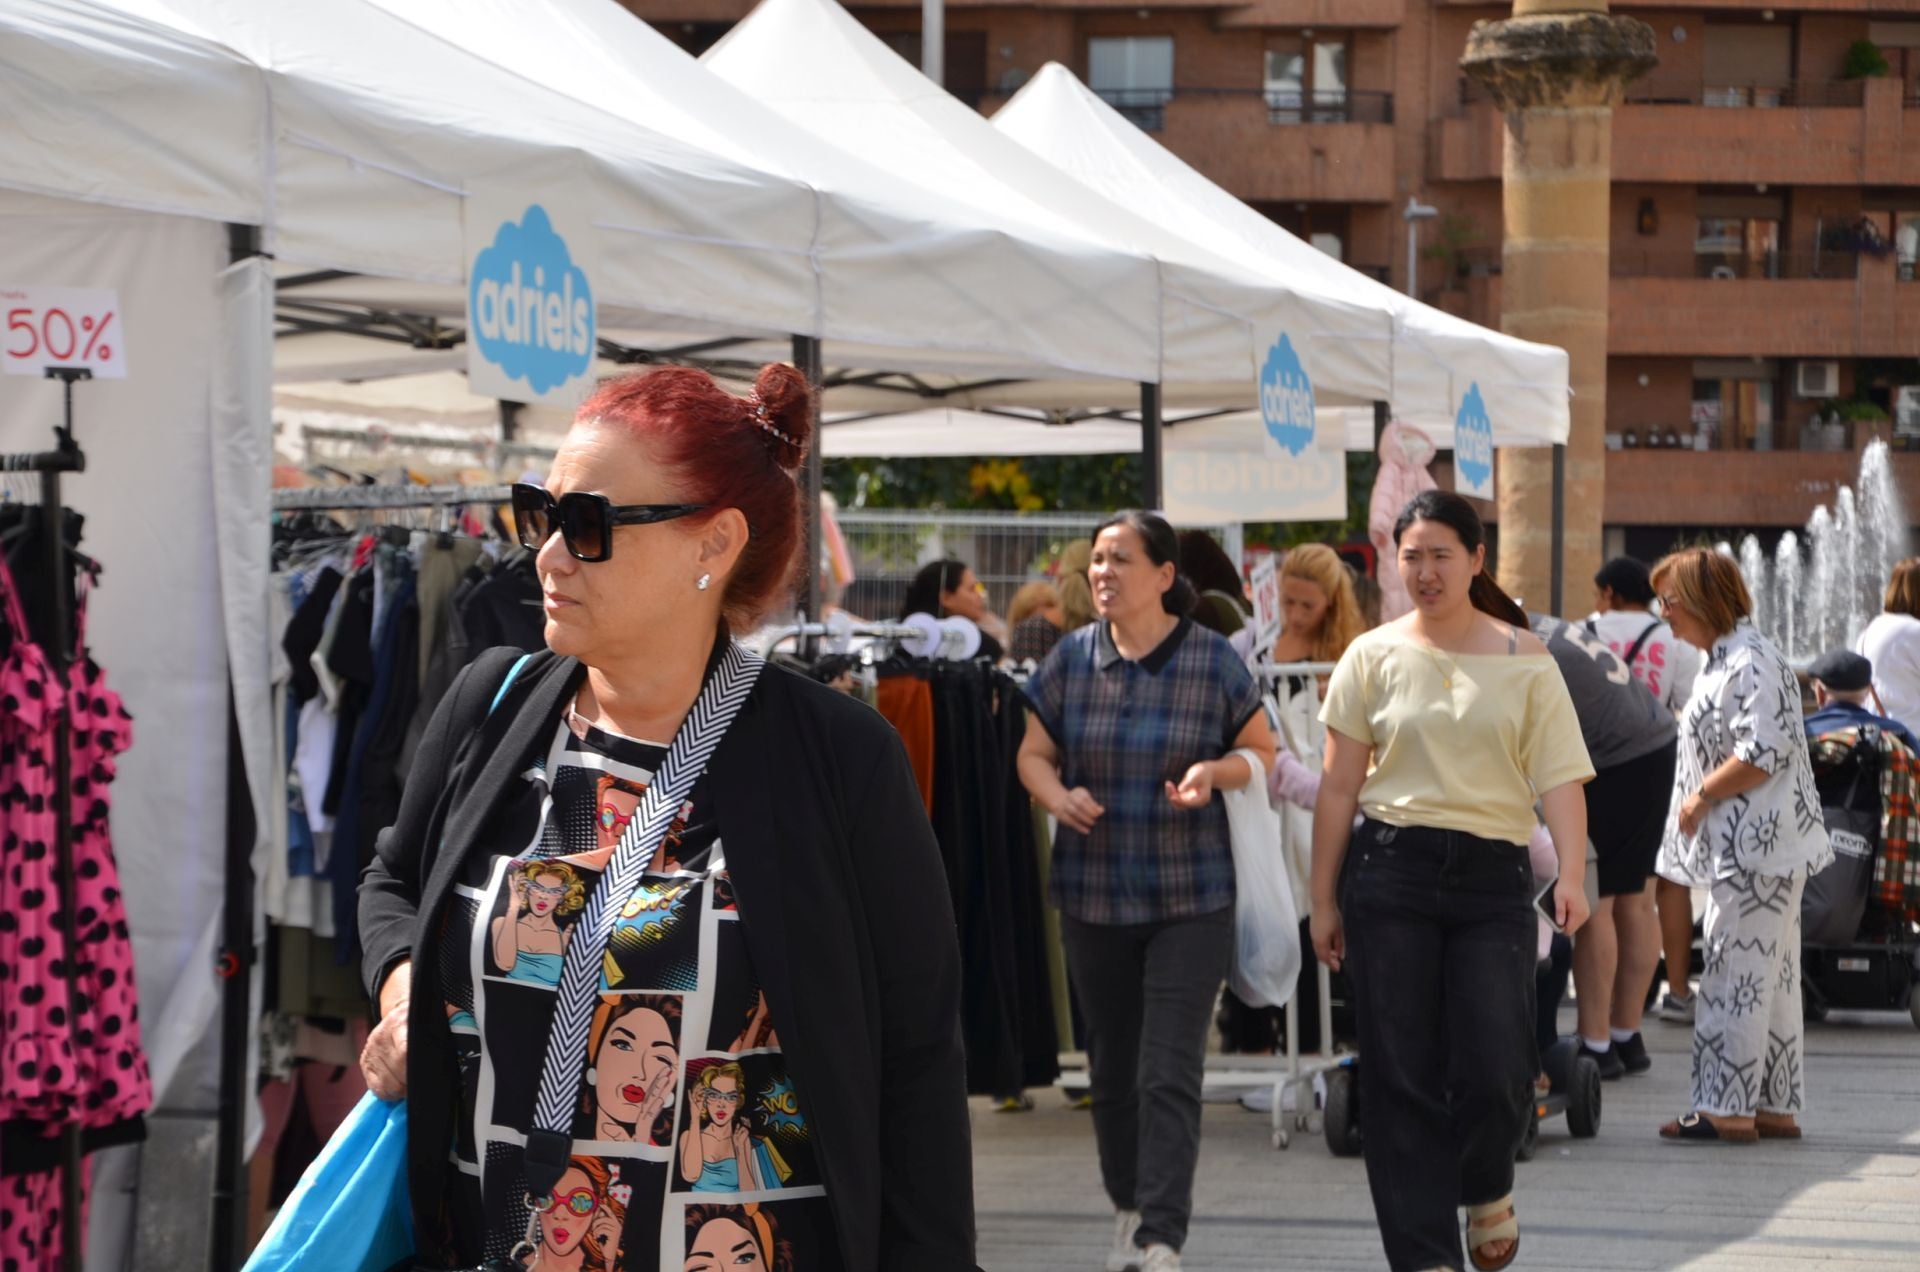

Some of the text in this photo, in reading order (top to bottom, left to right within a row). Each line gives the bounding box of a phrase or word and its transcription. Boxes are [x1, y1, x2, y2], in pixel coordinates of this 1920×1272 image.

[7, 308, 113, 360] 50%
[477, 260, 589, 356] adriels
[1263, 368, 1313, 428] adriels
[762, 1091, 799, 1115] WO
